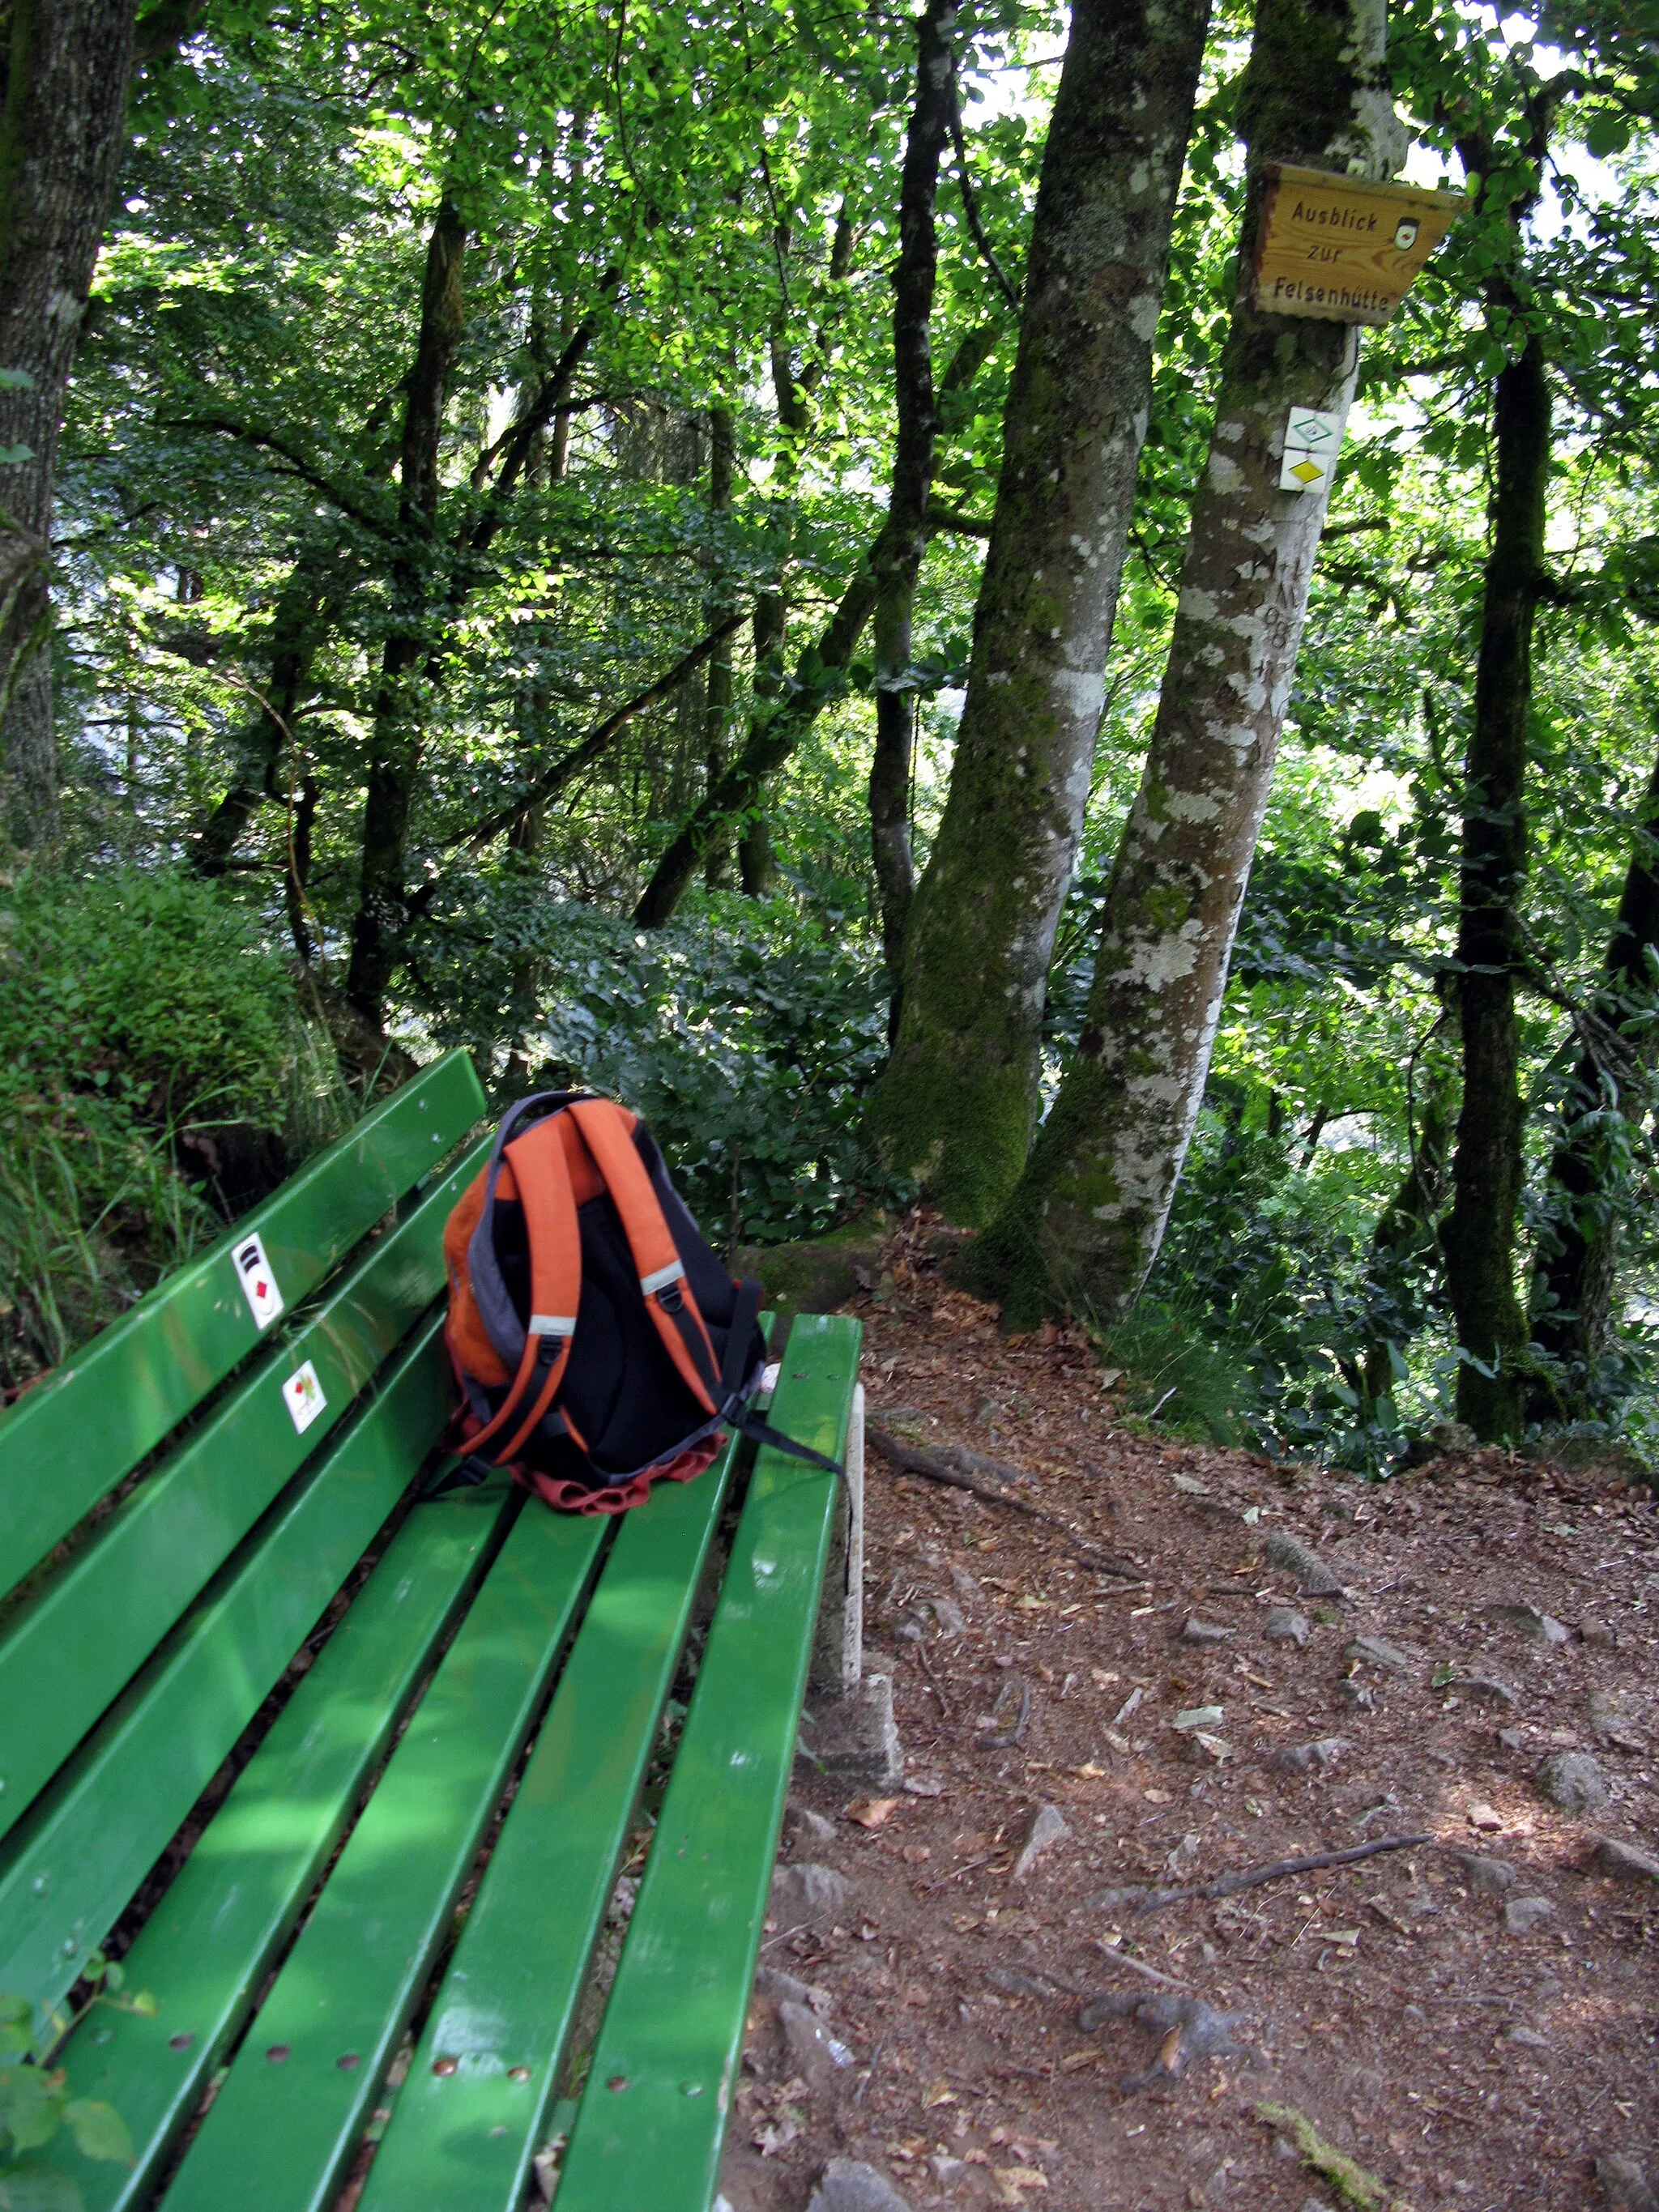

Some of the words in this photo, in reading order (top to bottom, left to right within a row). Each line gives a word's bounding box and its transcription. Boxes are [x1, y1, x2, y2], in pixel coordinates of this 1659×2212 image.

[1291, 202, 1378, 232] Ausblick
[1307, 245, 1342, 263] zur
[1274, 276, 1388, 311] Felsenhütte
